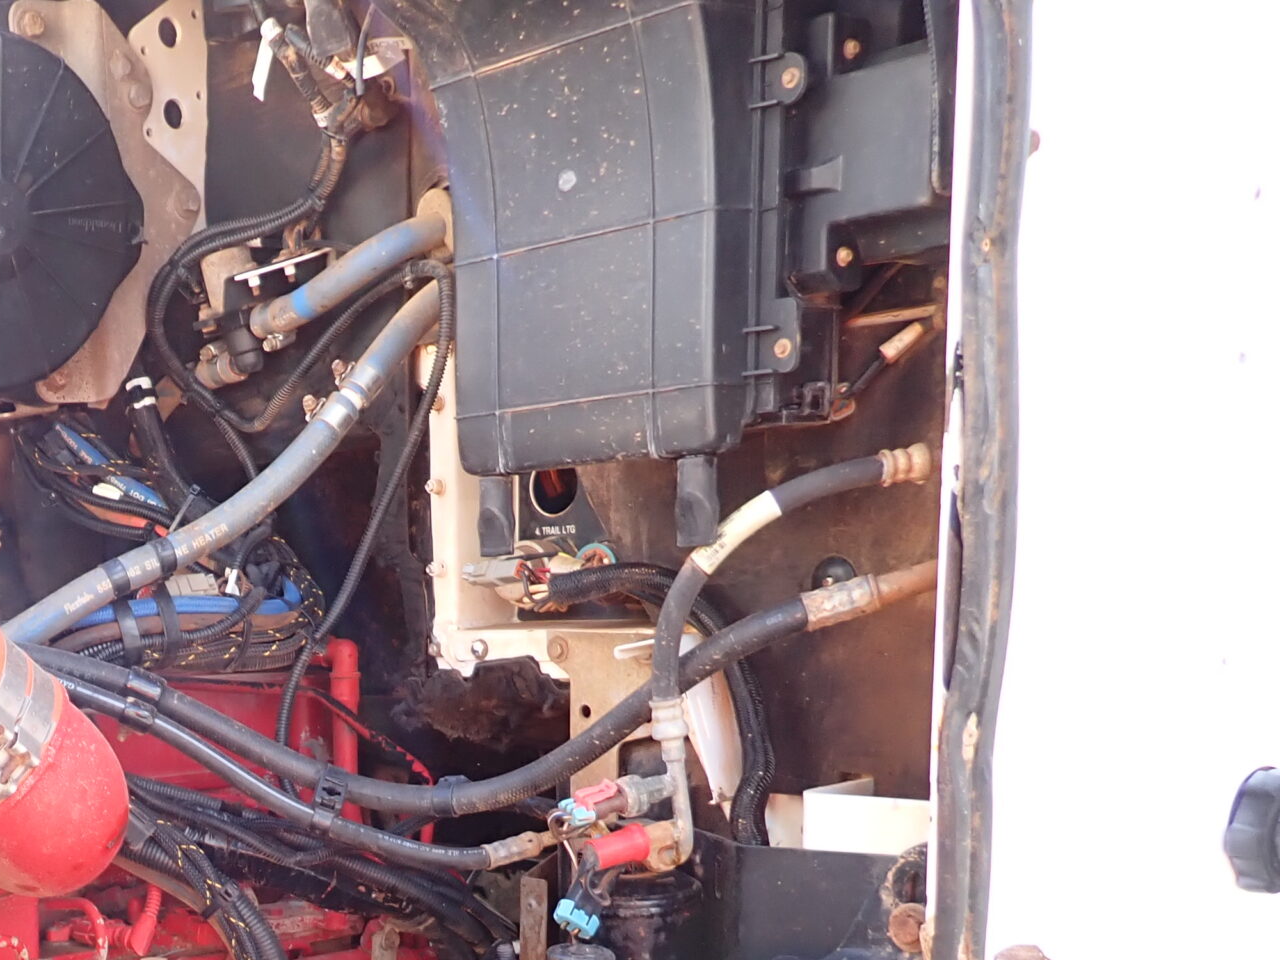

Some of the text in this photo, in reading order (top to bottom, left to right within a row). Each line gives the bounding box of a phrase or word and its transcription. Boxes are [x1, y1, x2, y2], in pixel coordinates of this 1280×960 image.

[192, 522, 229, 550] HEATER
[542, 525, 561, 536] TRAIL
[562, 524, 576, 535] LTG
